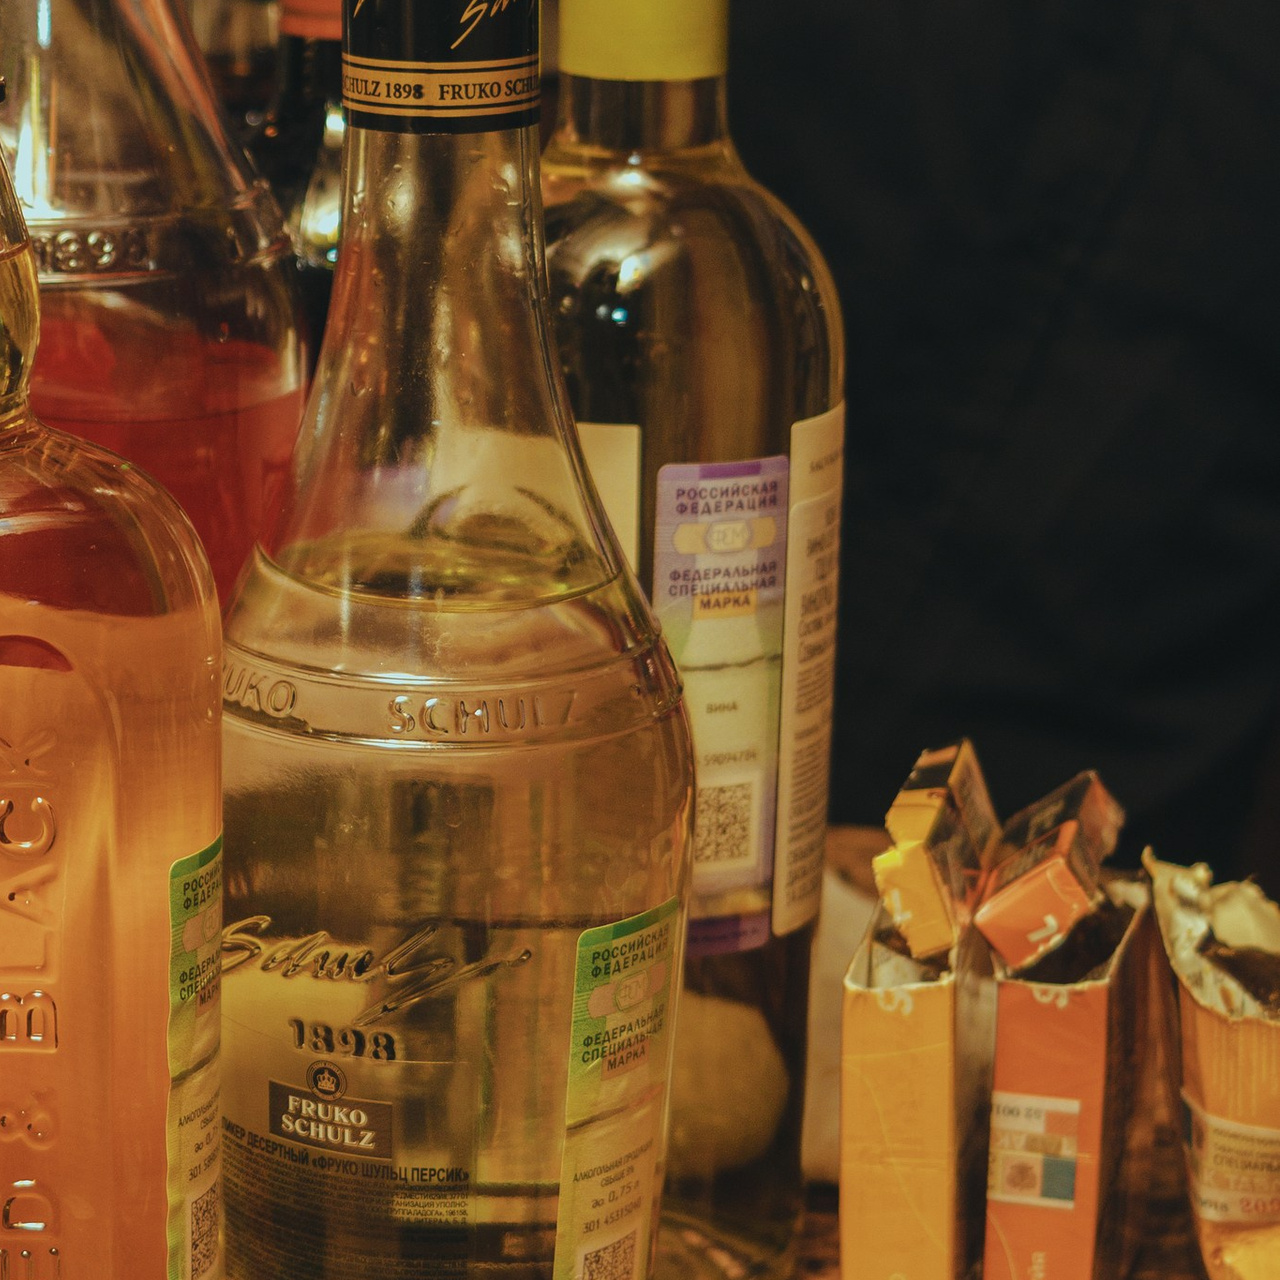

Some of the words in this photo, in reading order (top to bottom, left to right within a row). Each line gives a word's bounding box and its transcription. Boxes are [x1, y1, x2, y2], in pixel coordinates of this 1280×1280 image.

[385, 80, 424, 100] 1898
[438, 80, 502, 101] FRUKO
[504, 76, 540, 98] SCHUL
[676, 481, 778, 501] РОССИЙСКАЯ
[676, 496, 778, 515] ФЕДЕРАЦИЯ
[669, 561, 777, 583] ФЕДЕРАЛЬНАЯ
[668, 576, 777, 597] СПЕЦИАЛЬНАЯ
[699, 595, 752, 611] МАРКА
[592, 925, 669, 964] РОССИЙСКАЯ
[591, 940, 668, 978] ФЕДЕРАЦИЯ
[583, 1003, 665, 1048] ФЕДЕРАЛЬНАЯ
[288, 1018, 399, 1061] 1898
[582, 1019, 664, 1063] СПЕЦИАЛЬНАЯ
[607, 1045, 646, 1071] МАРКА
[288, 1095, 368, 1128] FRUKO
[281, 1114, 376, 1150] SCHULZ
[246, 1131, 310, 1165] ДЕСЕРТНЫЙ
[361, 1162, 408, 1183] ШУЛЬЦ
[411, 1167, 470, 1182] ПЕРСИК»
[583, 1219, 600, 1234] 301
